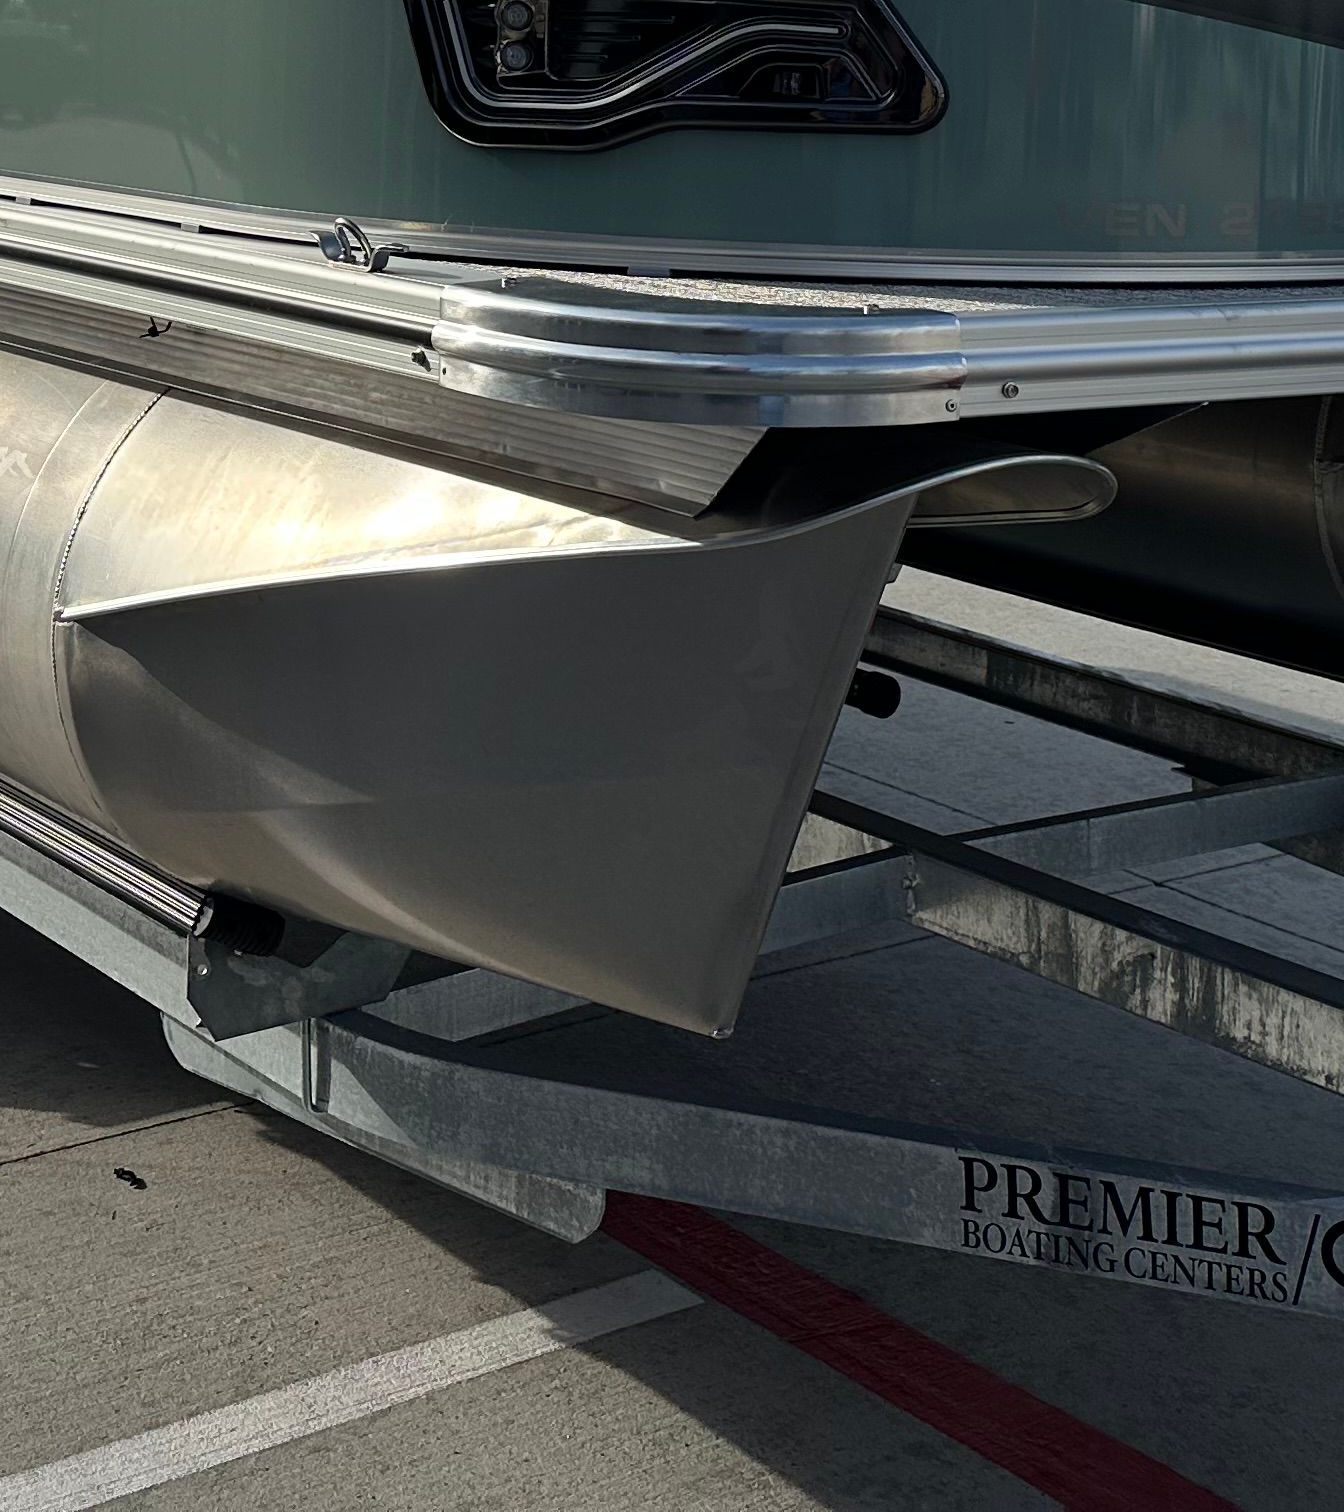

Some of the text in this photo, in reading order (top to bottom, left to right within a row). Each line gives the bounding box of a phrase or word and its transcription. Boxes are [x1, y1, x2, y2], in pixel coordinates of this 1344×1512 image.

[958, 1156, 1288, 1266] PREMIER
[960, 1218, 1288, 1304] BOATING CENTERS
